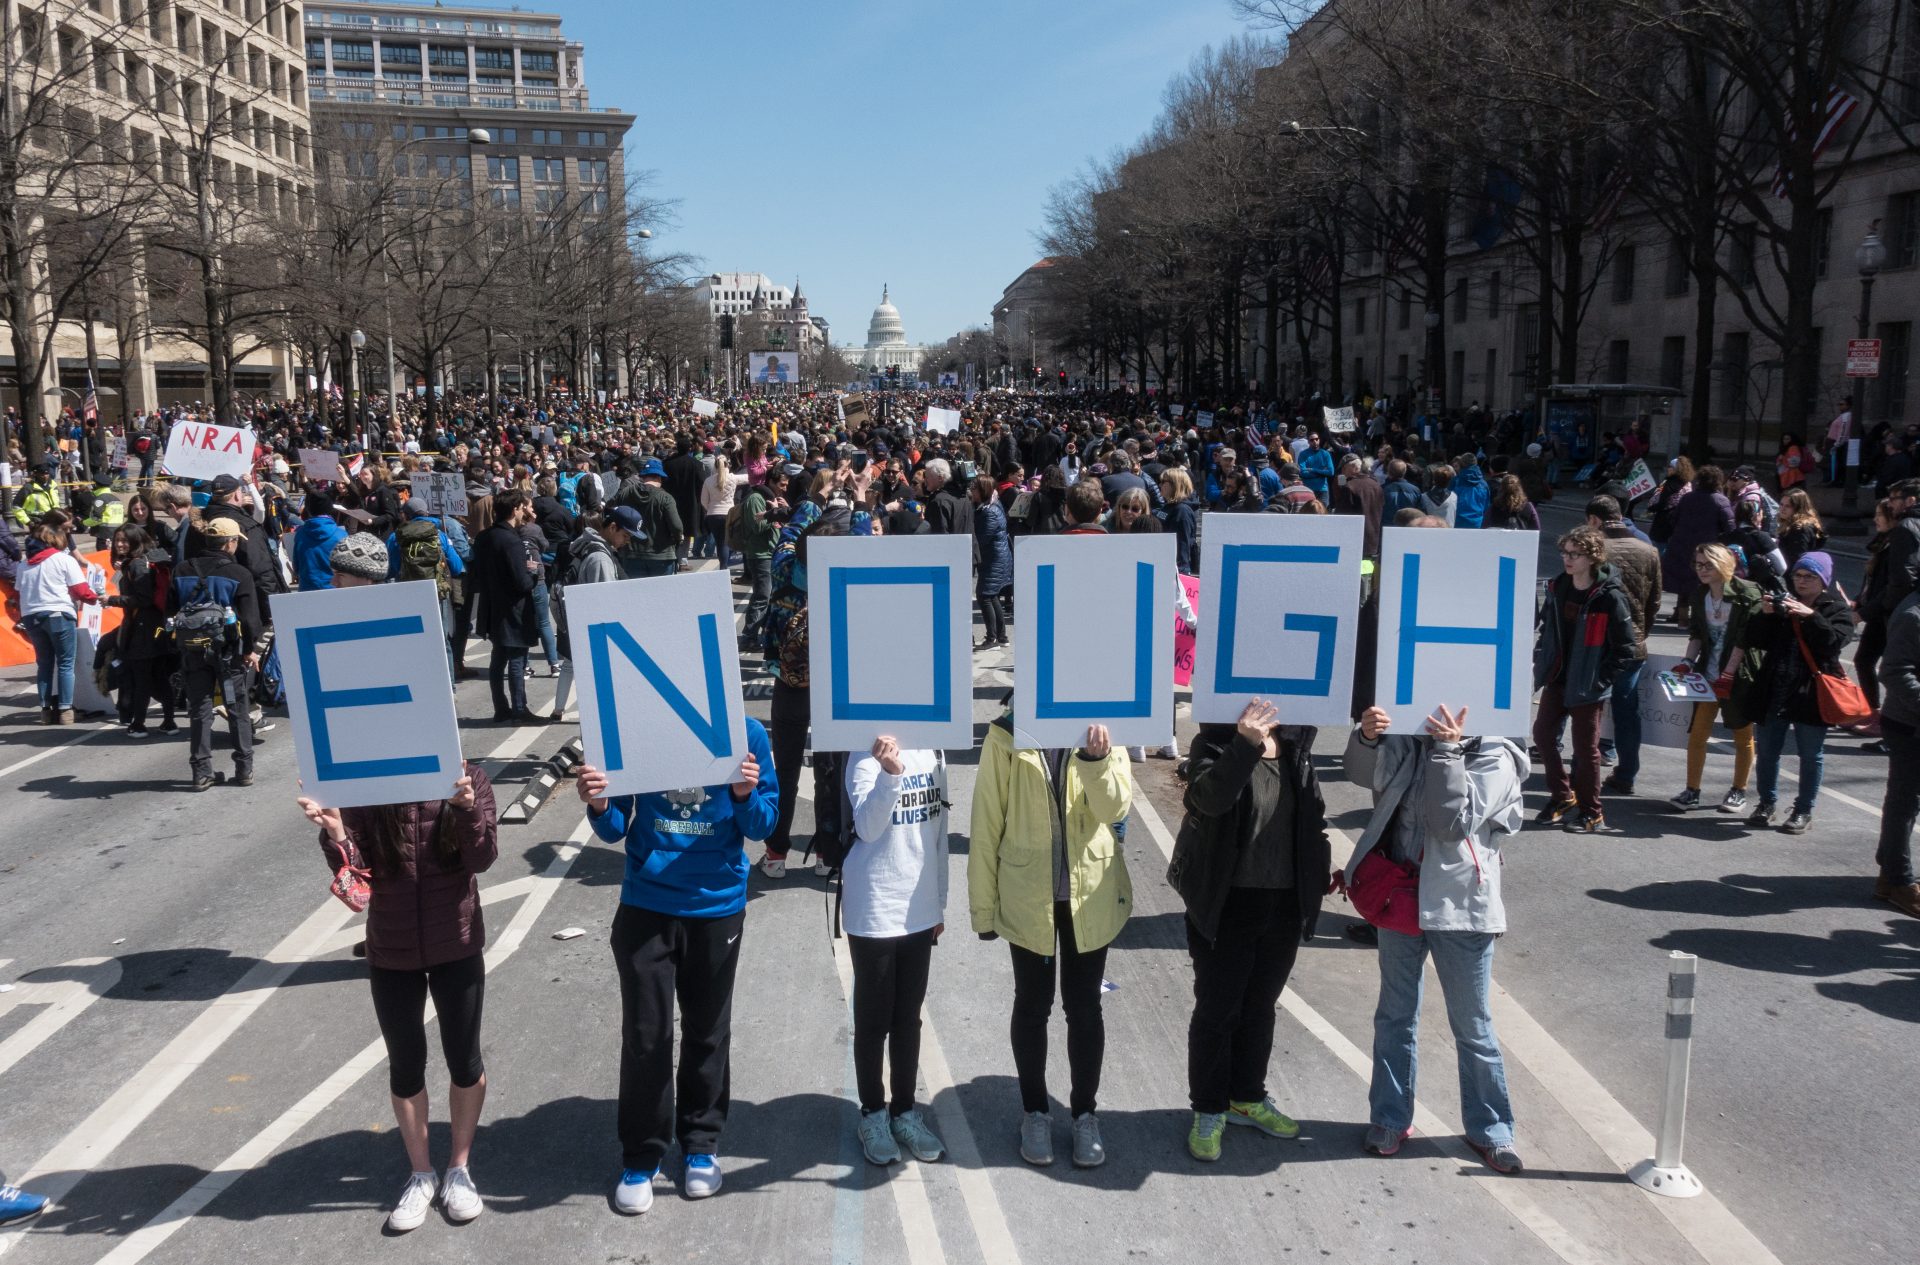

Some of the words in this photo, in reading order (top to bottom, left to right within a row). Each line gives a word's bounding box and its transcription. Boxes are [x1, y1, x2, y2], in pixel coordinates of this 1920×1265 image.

[420, 489, 453, 500] VOTE
[892, 807, 928, 825] LIVES
[654, 818, 714, 836] BASEBALL
